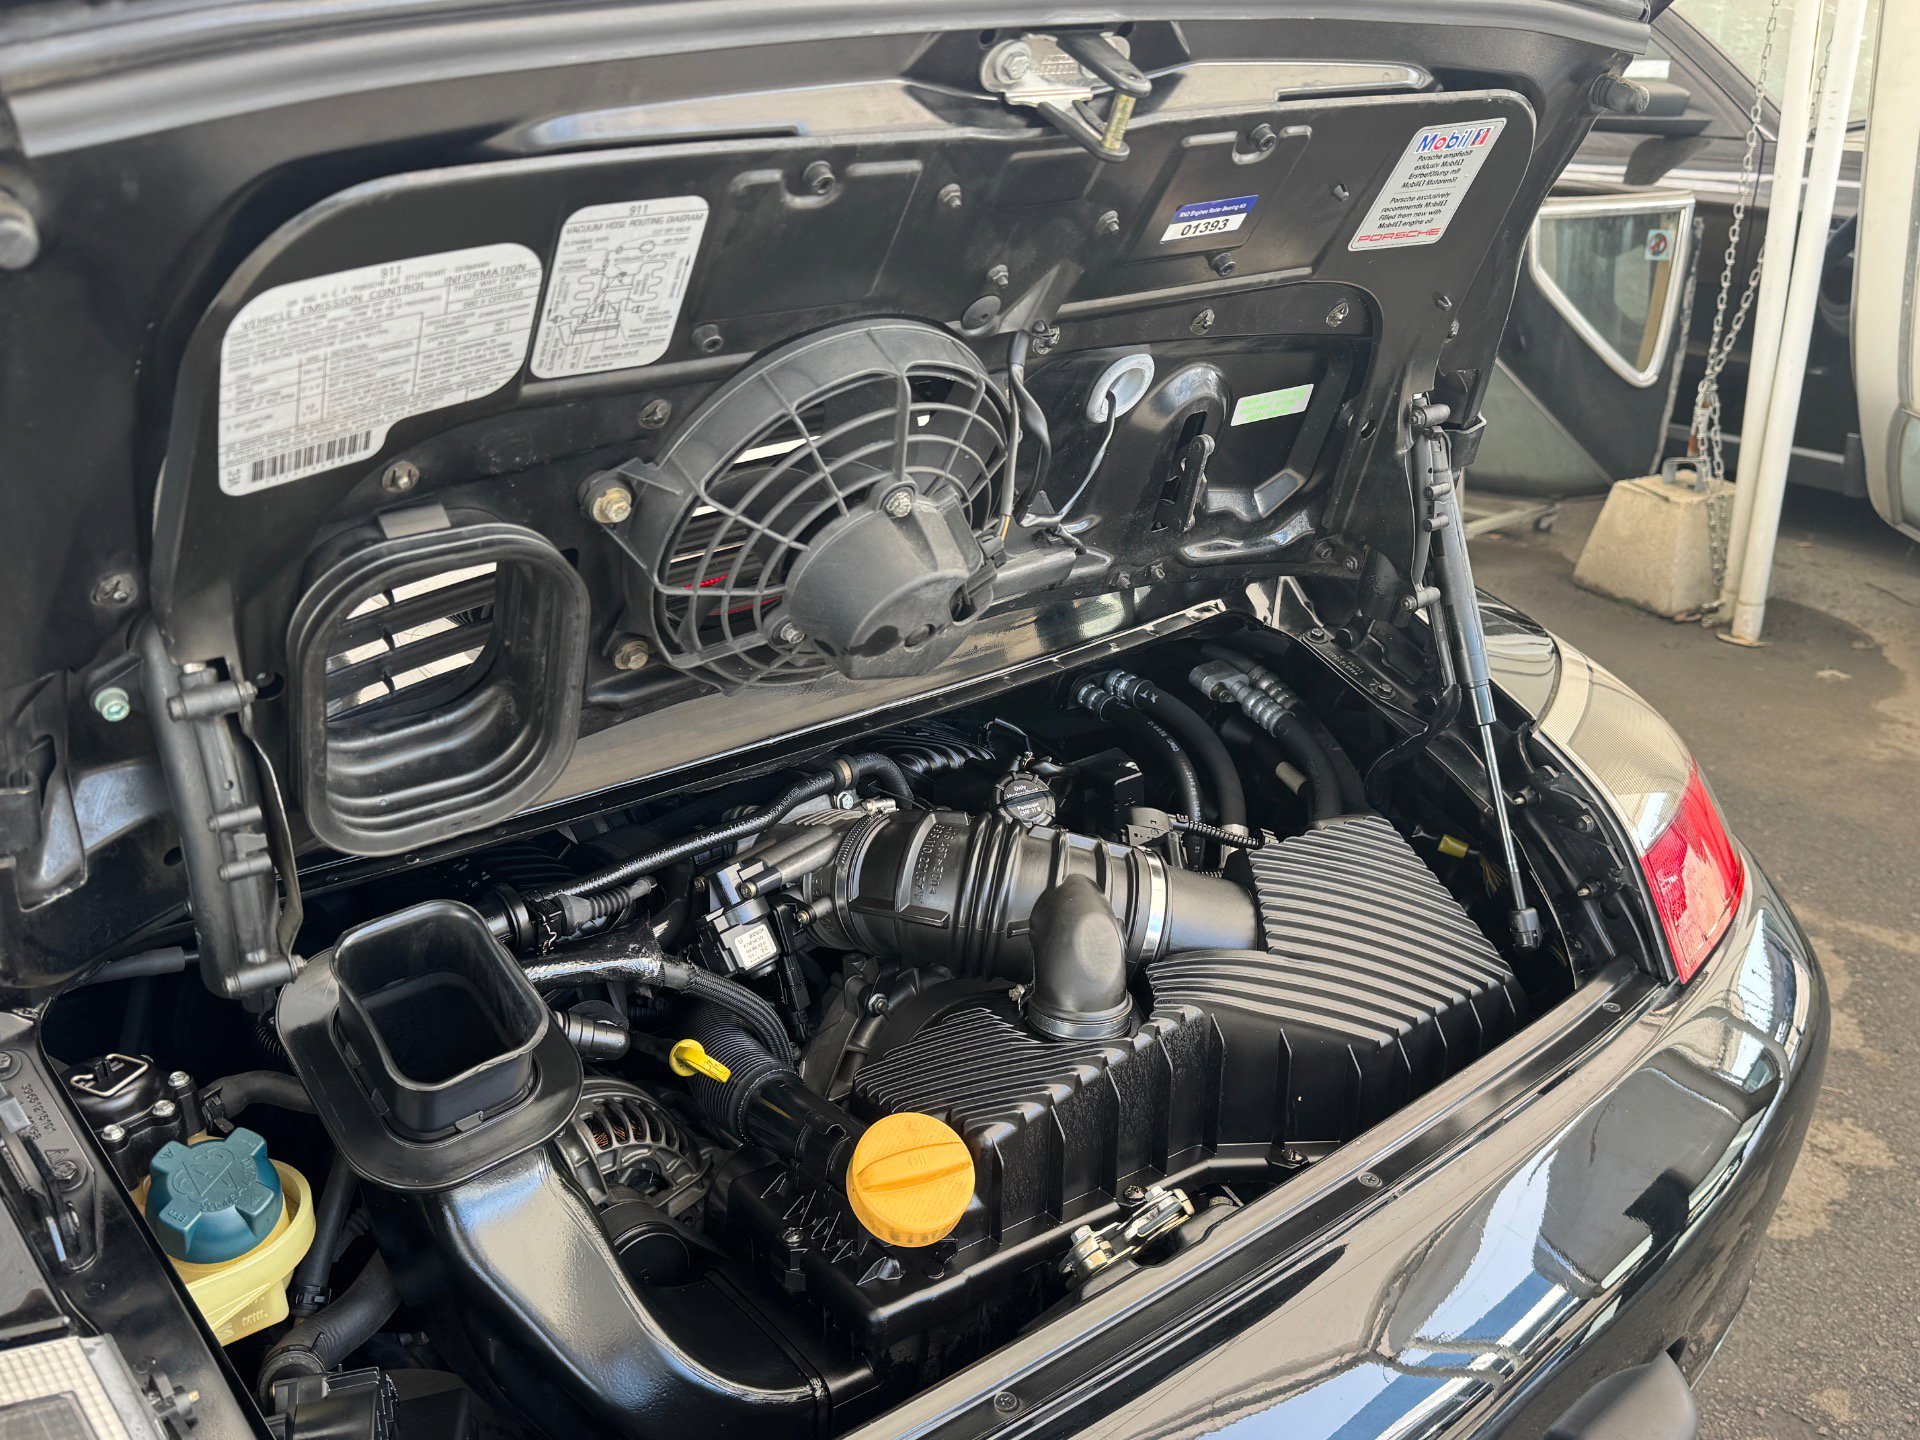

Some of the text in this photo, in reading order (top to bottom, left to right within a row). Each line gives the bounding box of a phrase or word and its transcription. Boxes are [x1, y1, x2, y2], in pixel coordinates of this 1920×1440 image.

[1415, 129, 1473, 152] Mobil
[1417, 154, 1442, 162] Porsche
[1390, 192, 1451, 204] Porsche exclusively
[629, 204, 649, 217] 911
[1378, 213, 1396, 221] Filled
[1428, 208, 1442, 216] with
[1381, 204, 1423, 213] recommends
[566, 213, 704, 235] VACUUM HOSE ROUTING DIAGRAM
[1180, 218, 1230, 236] 01393
[1402, 219, 1424, 228] engine
[1357, 228, 1441, 243] PORSCHE
[381, 265, 401, 279] 911
[453, 271, 539, 292] THREE WAY CATALYTIC
[241, 311, 297, 330] VEHICLE
[301, 296, 363, 315] EMISSION
[369, 281, 424, 300] CONTROL
[443, 263, 527, 286] INFORMATION
[473, 282, 517, 297] CONVERTER
